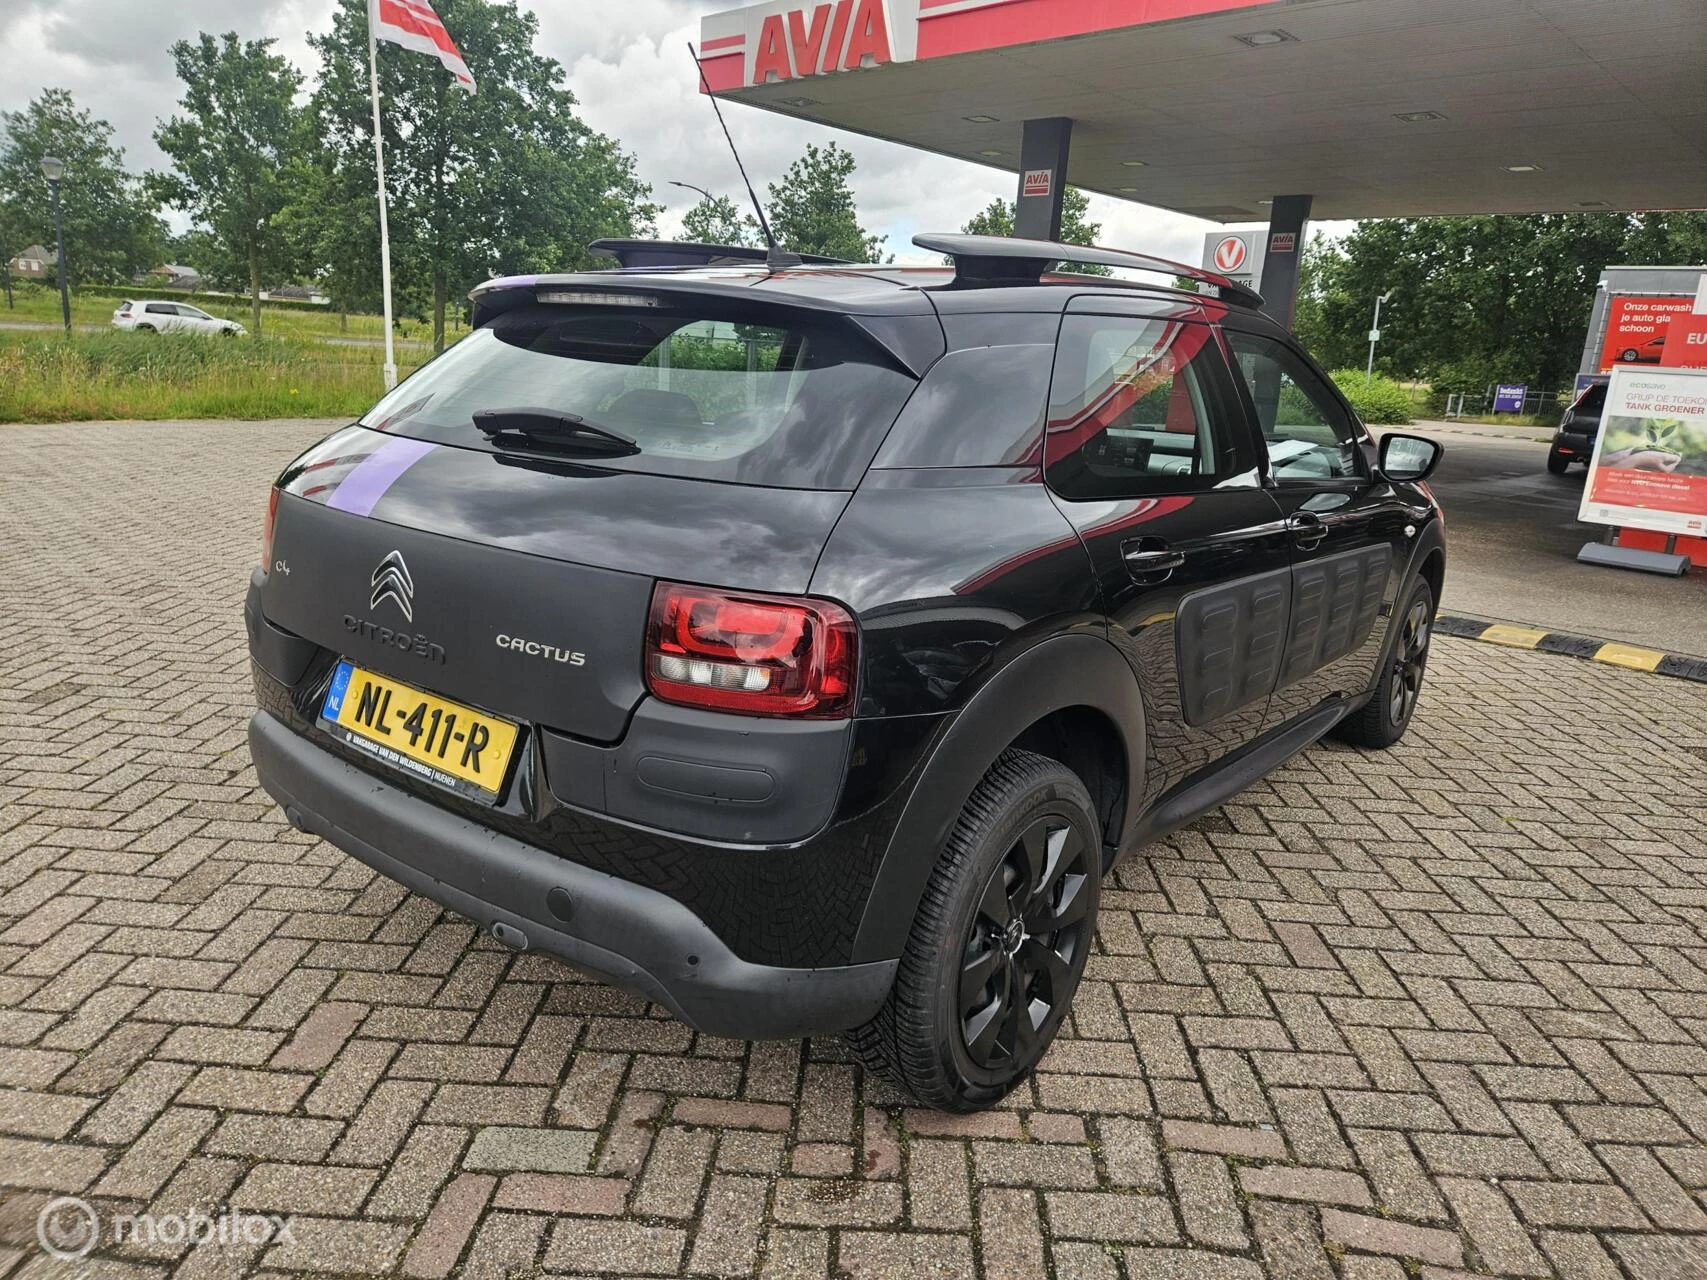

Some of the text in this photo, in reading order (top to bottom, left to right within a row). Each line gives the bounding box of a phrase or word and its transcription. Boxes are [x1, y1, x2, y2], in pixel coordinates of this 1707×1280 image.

[753, 0, 892, 84] AVIA
[1026, 171, 1049, 185] AVIA
[1272, 233, 1293, 244] AVIA
[1623, 302, 1692, 312] Onze carwash
[1620, 313, 1631, 323] je
[1632, 314, 1654, 322] auto
[1619, 324, 1655, 332] schoon
[1656, 394, 1670, 402] DE
[1626, 402, 1705, 414] TANK GROENER
[275, 559, 291, 577] C4
[495, 633, 586, 667] CACTUS
[328, 695, 340, 711] NL
[354, 681, 490, 773] NL-411-R
[379, 747, 389, 758] VAN
[399, 754, 433, 777] WILDENBERG
